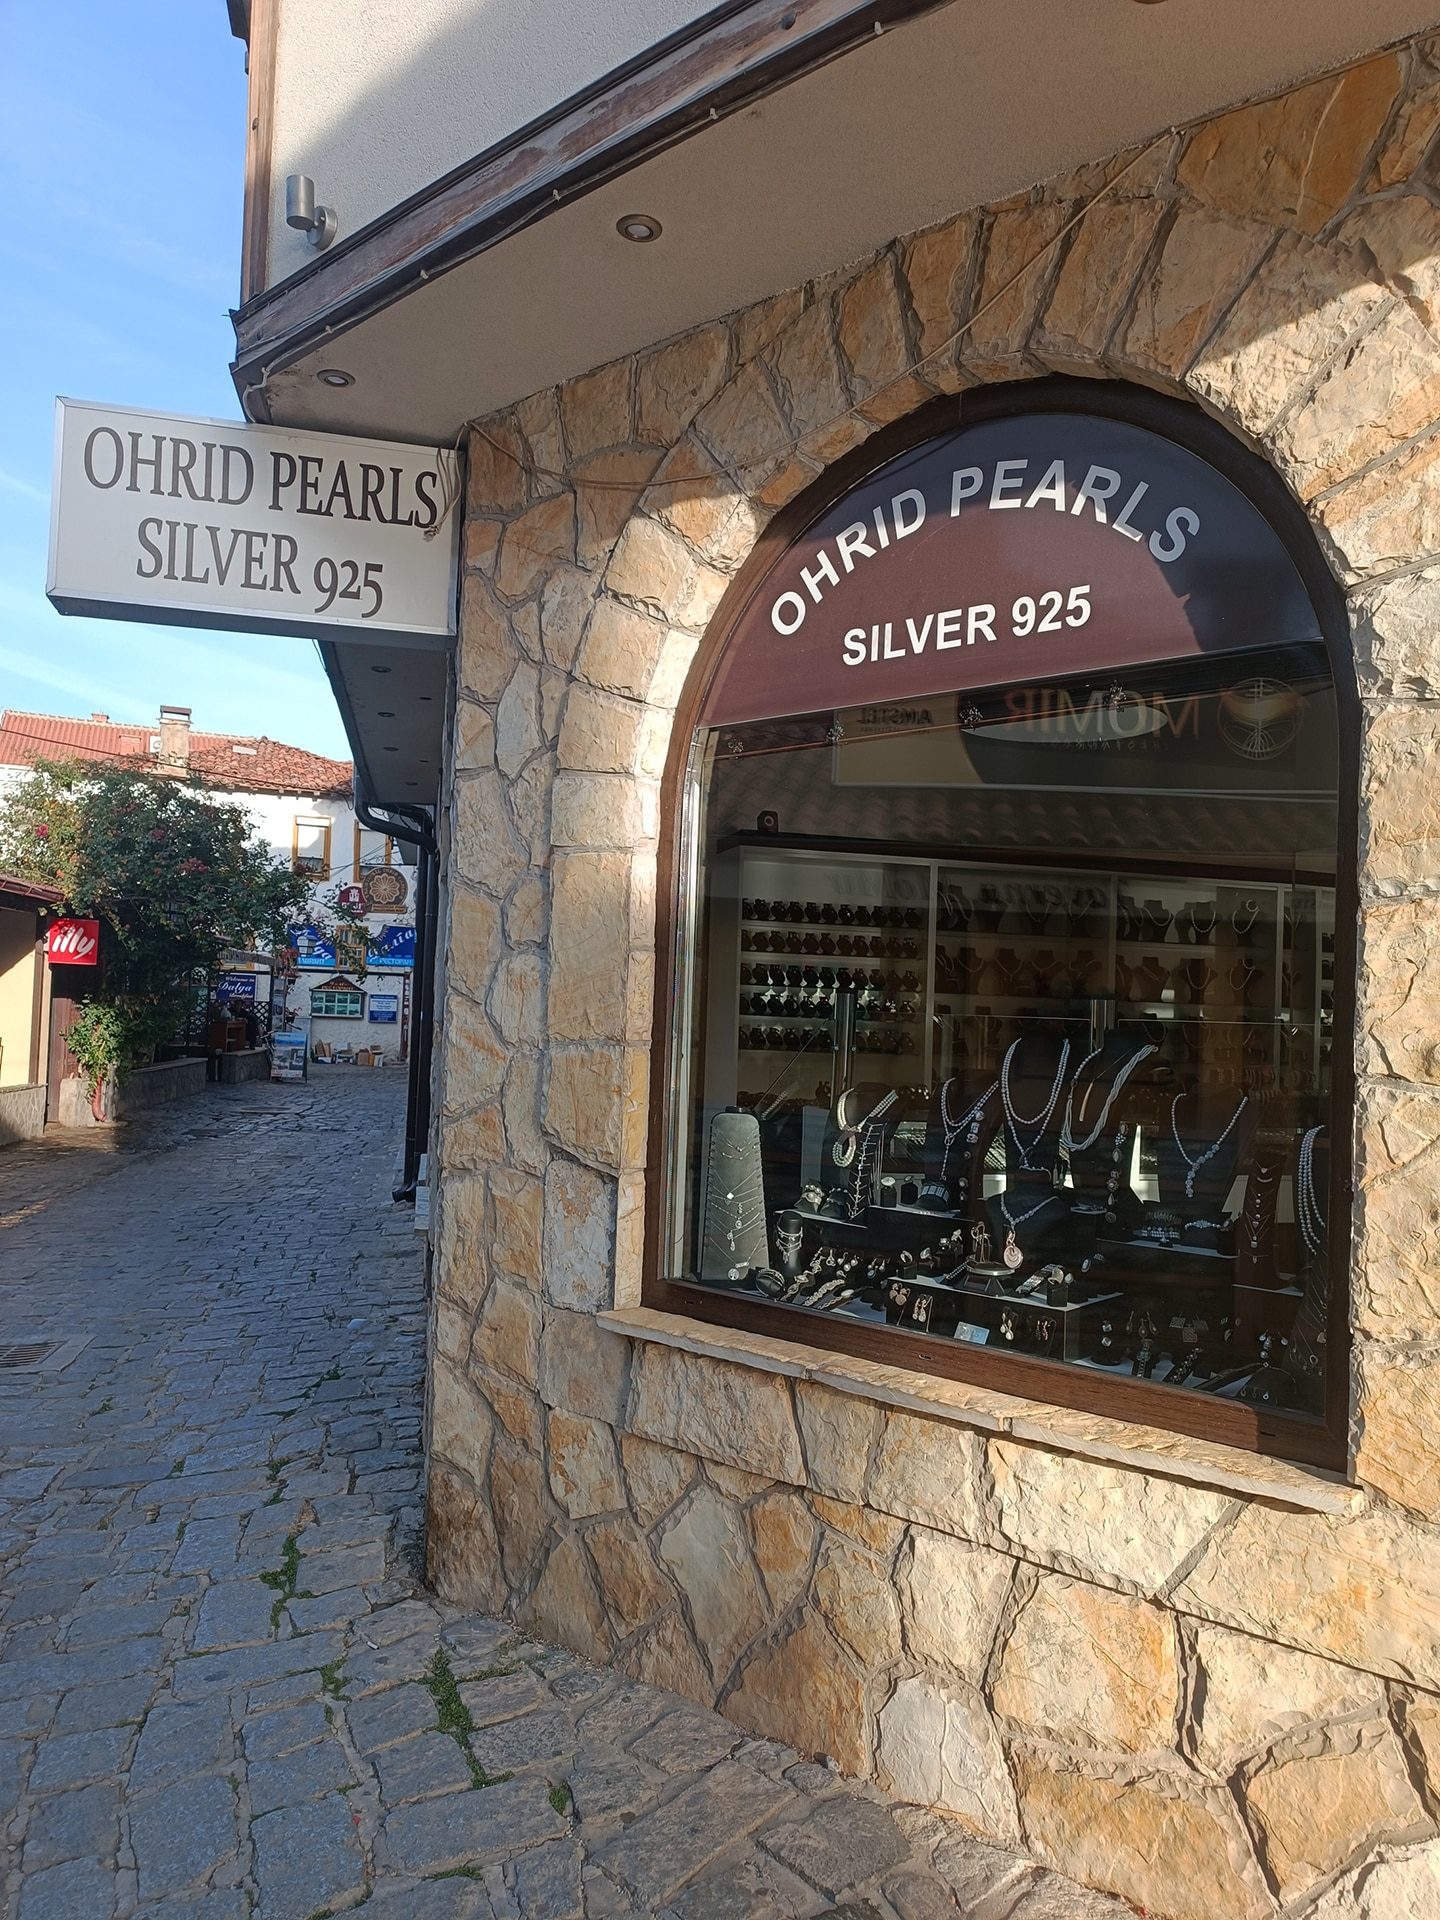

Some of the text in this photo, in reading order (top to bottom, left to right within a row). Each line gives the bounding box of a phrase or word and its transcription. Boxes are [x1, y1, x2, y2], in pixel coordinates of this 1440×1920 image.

[84, 426, 438, 528] OHRID PEARLS
[136, 517, 384, 618] SILVER 925
[771, 458, 1201, 635] OHRID PEARLS
[842, 584, 1092, 666] SILVER 925
[52, 925, 95, 960] illy
[218, 981, 252, 994] Dalga
